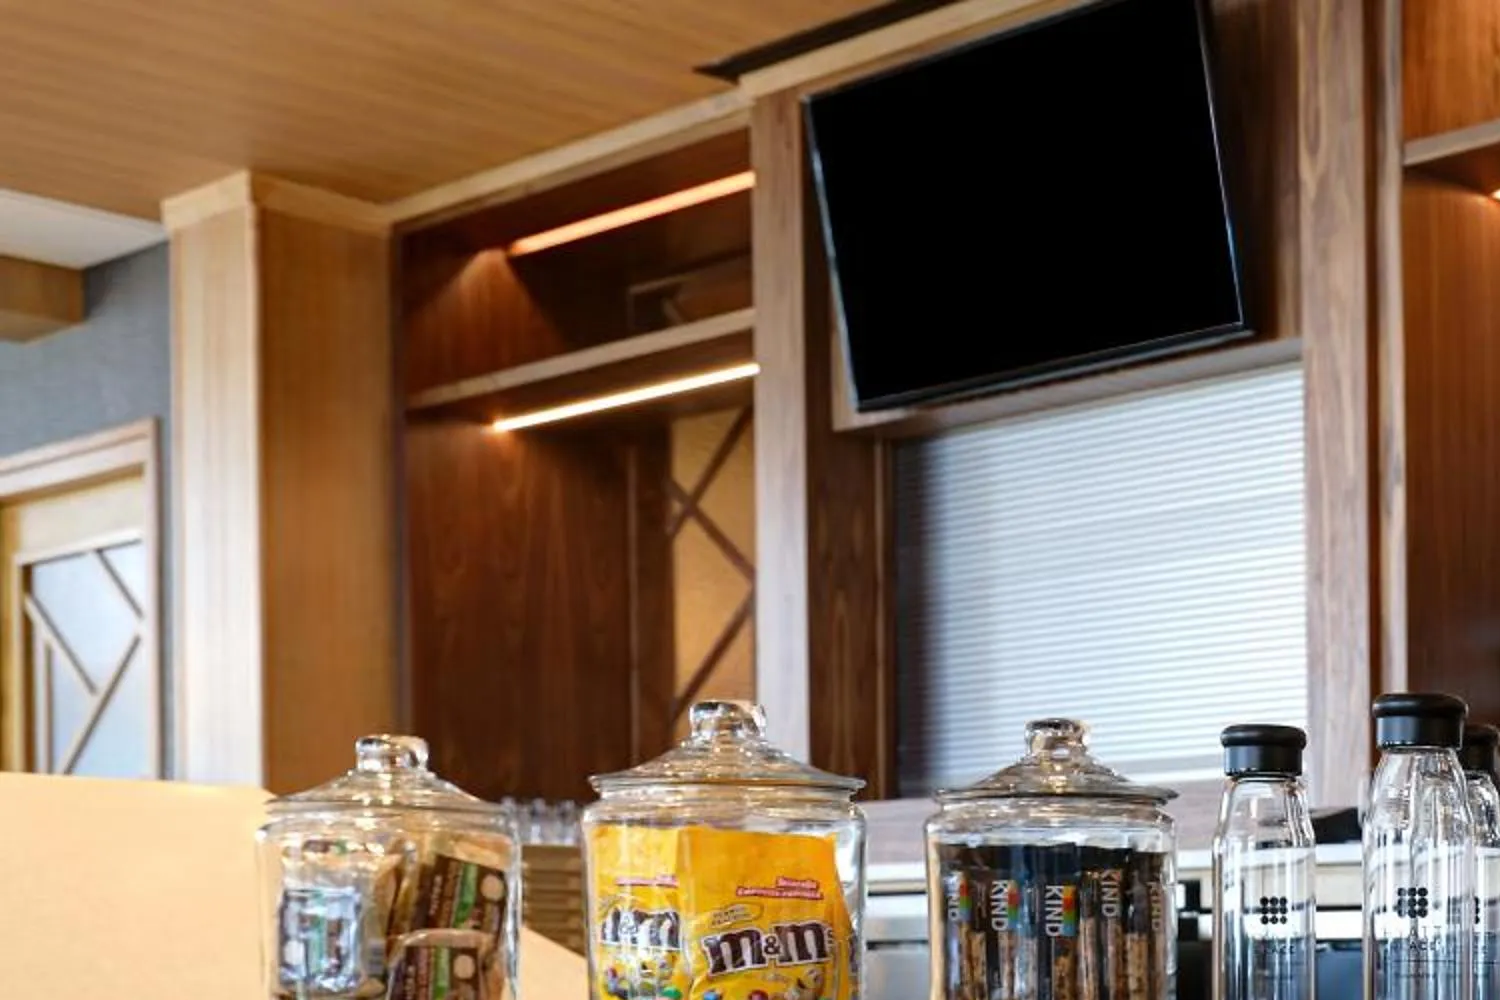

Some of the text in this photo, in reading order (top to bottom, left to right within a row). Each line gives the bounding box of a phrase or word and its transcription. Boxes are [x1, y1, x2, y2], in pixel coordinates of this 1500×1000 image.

[991, 880, 1009, 932] KIND
[1045, 885, 1064, 937] KIND
[1101, 869, 1121, 917] KIND
